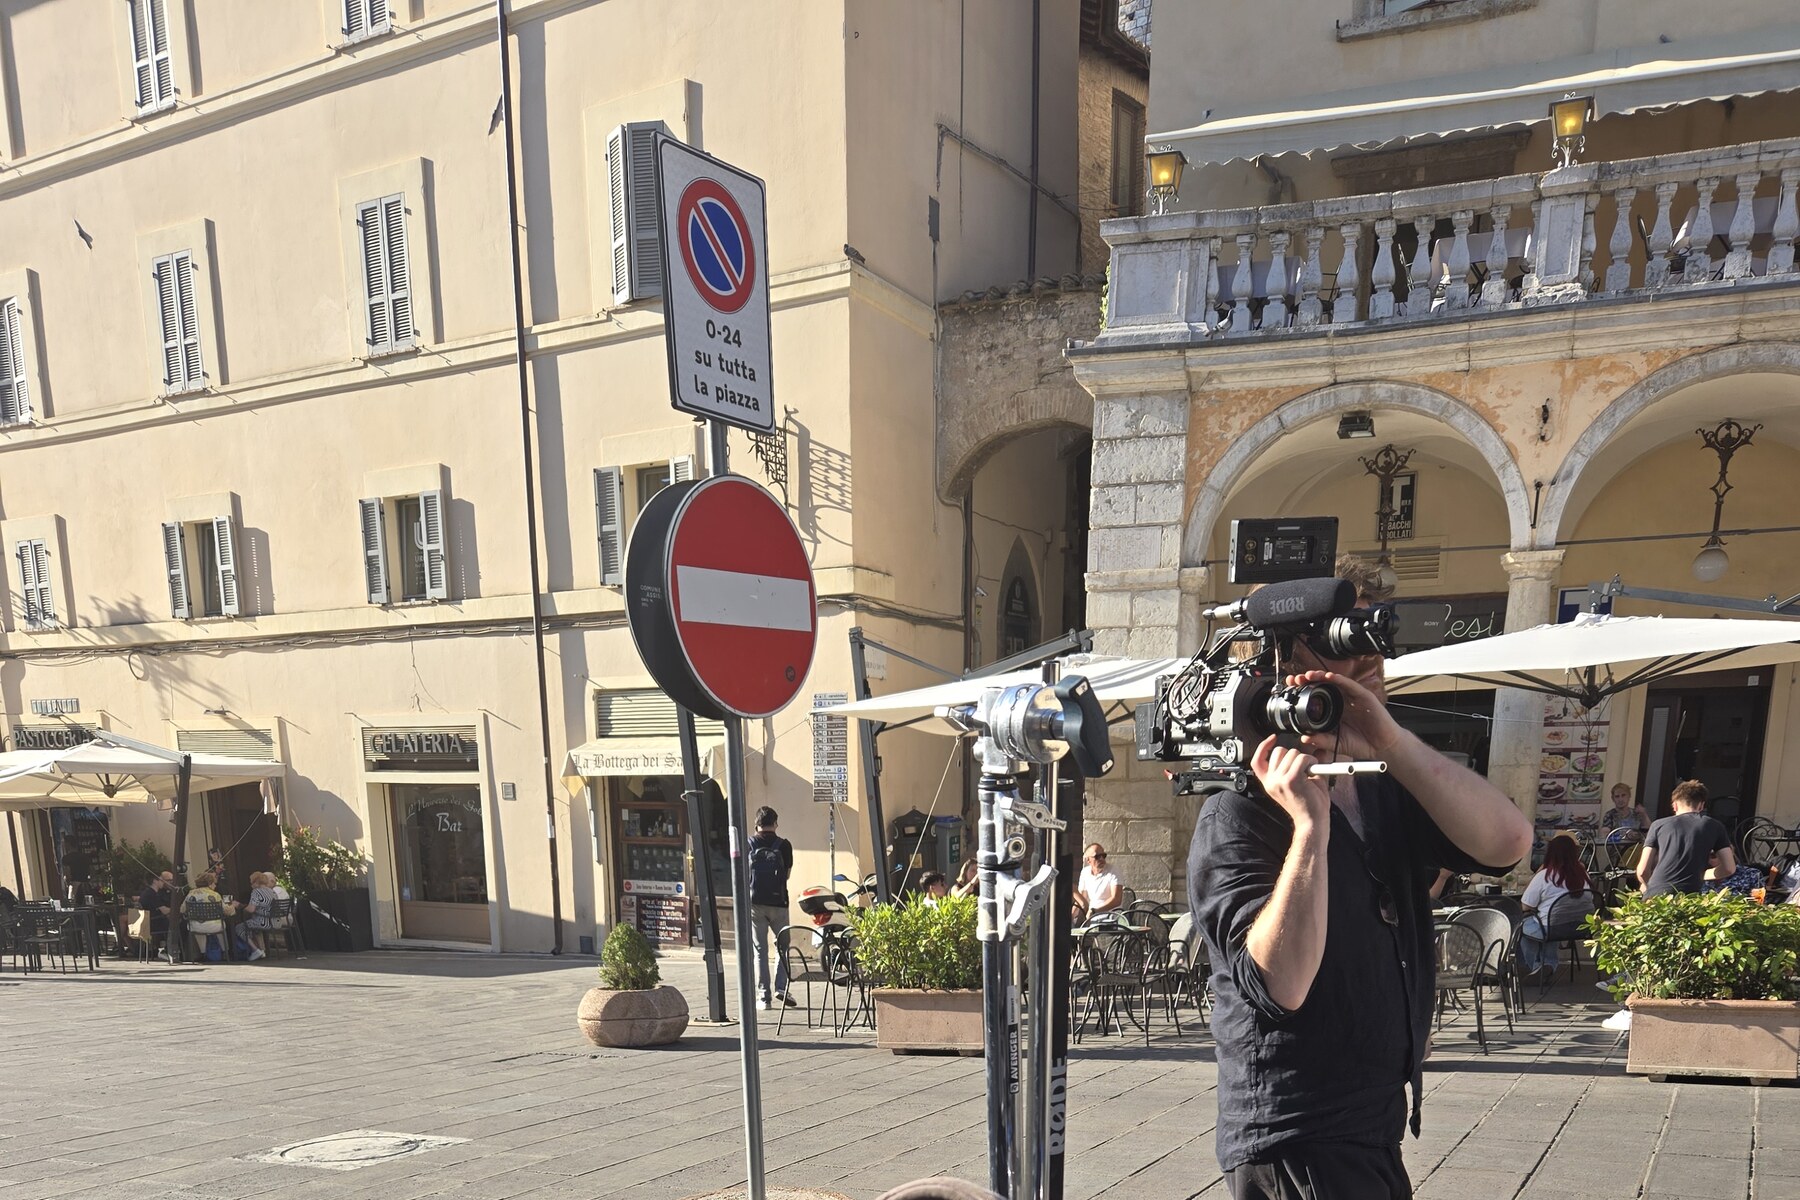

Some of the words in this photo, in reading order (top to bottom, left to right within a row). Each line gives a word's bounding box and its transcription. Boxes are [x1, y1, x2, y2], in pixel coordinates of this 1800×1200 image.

[706, 319, 742, 348] 0-24
[695, 350, 712, 368] su
[718, 353, 757, 382] tutta
[694, 374, 709, 396] la
[715, 383, 760, 412] piazza
[1380, 520, 1411, 531] TBACCHI
[1270, 597, 1305, 615] RØDE
[370, 733, 462, 753] GELATERIA
[573, 754, 590, 769] La
[592, 753, 639, 771] Bottega
[642, 752, 660, 768] dei
[436, 813, 462, 832] Bar
[1010, 1031, 1018, 1079] AVENGER
[1049, 1056, 1067, 1156] RØDE
